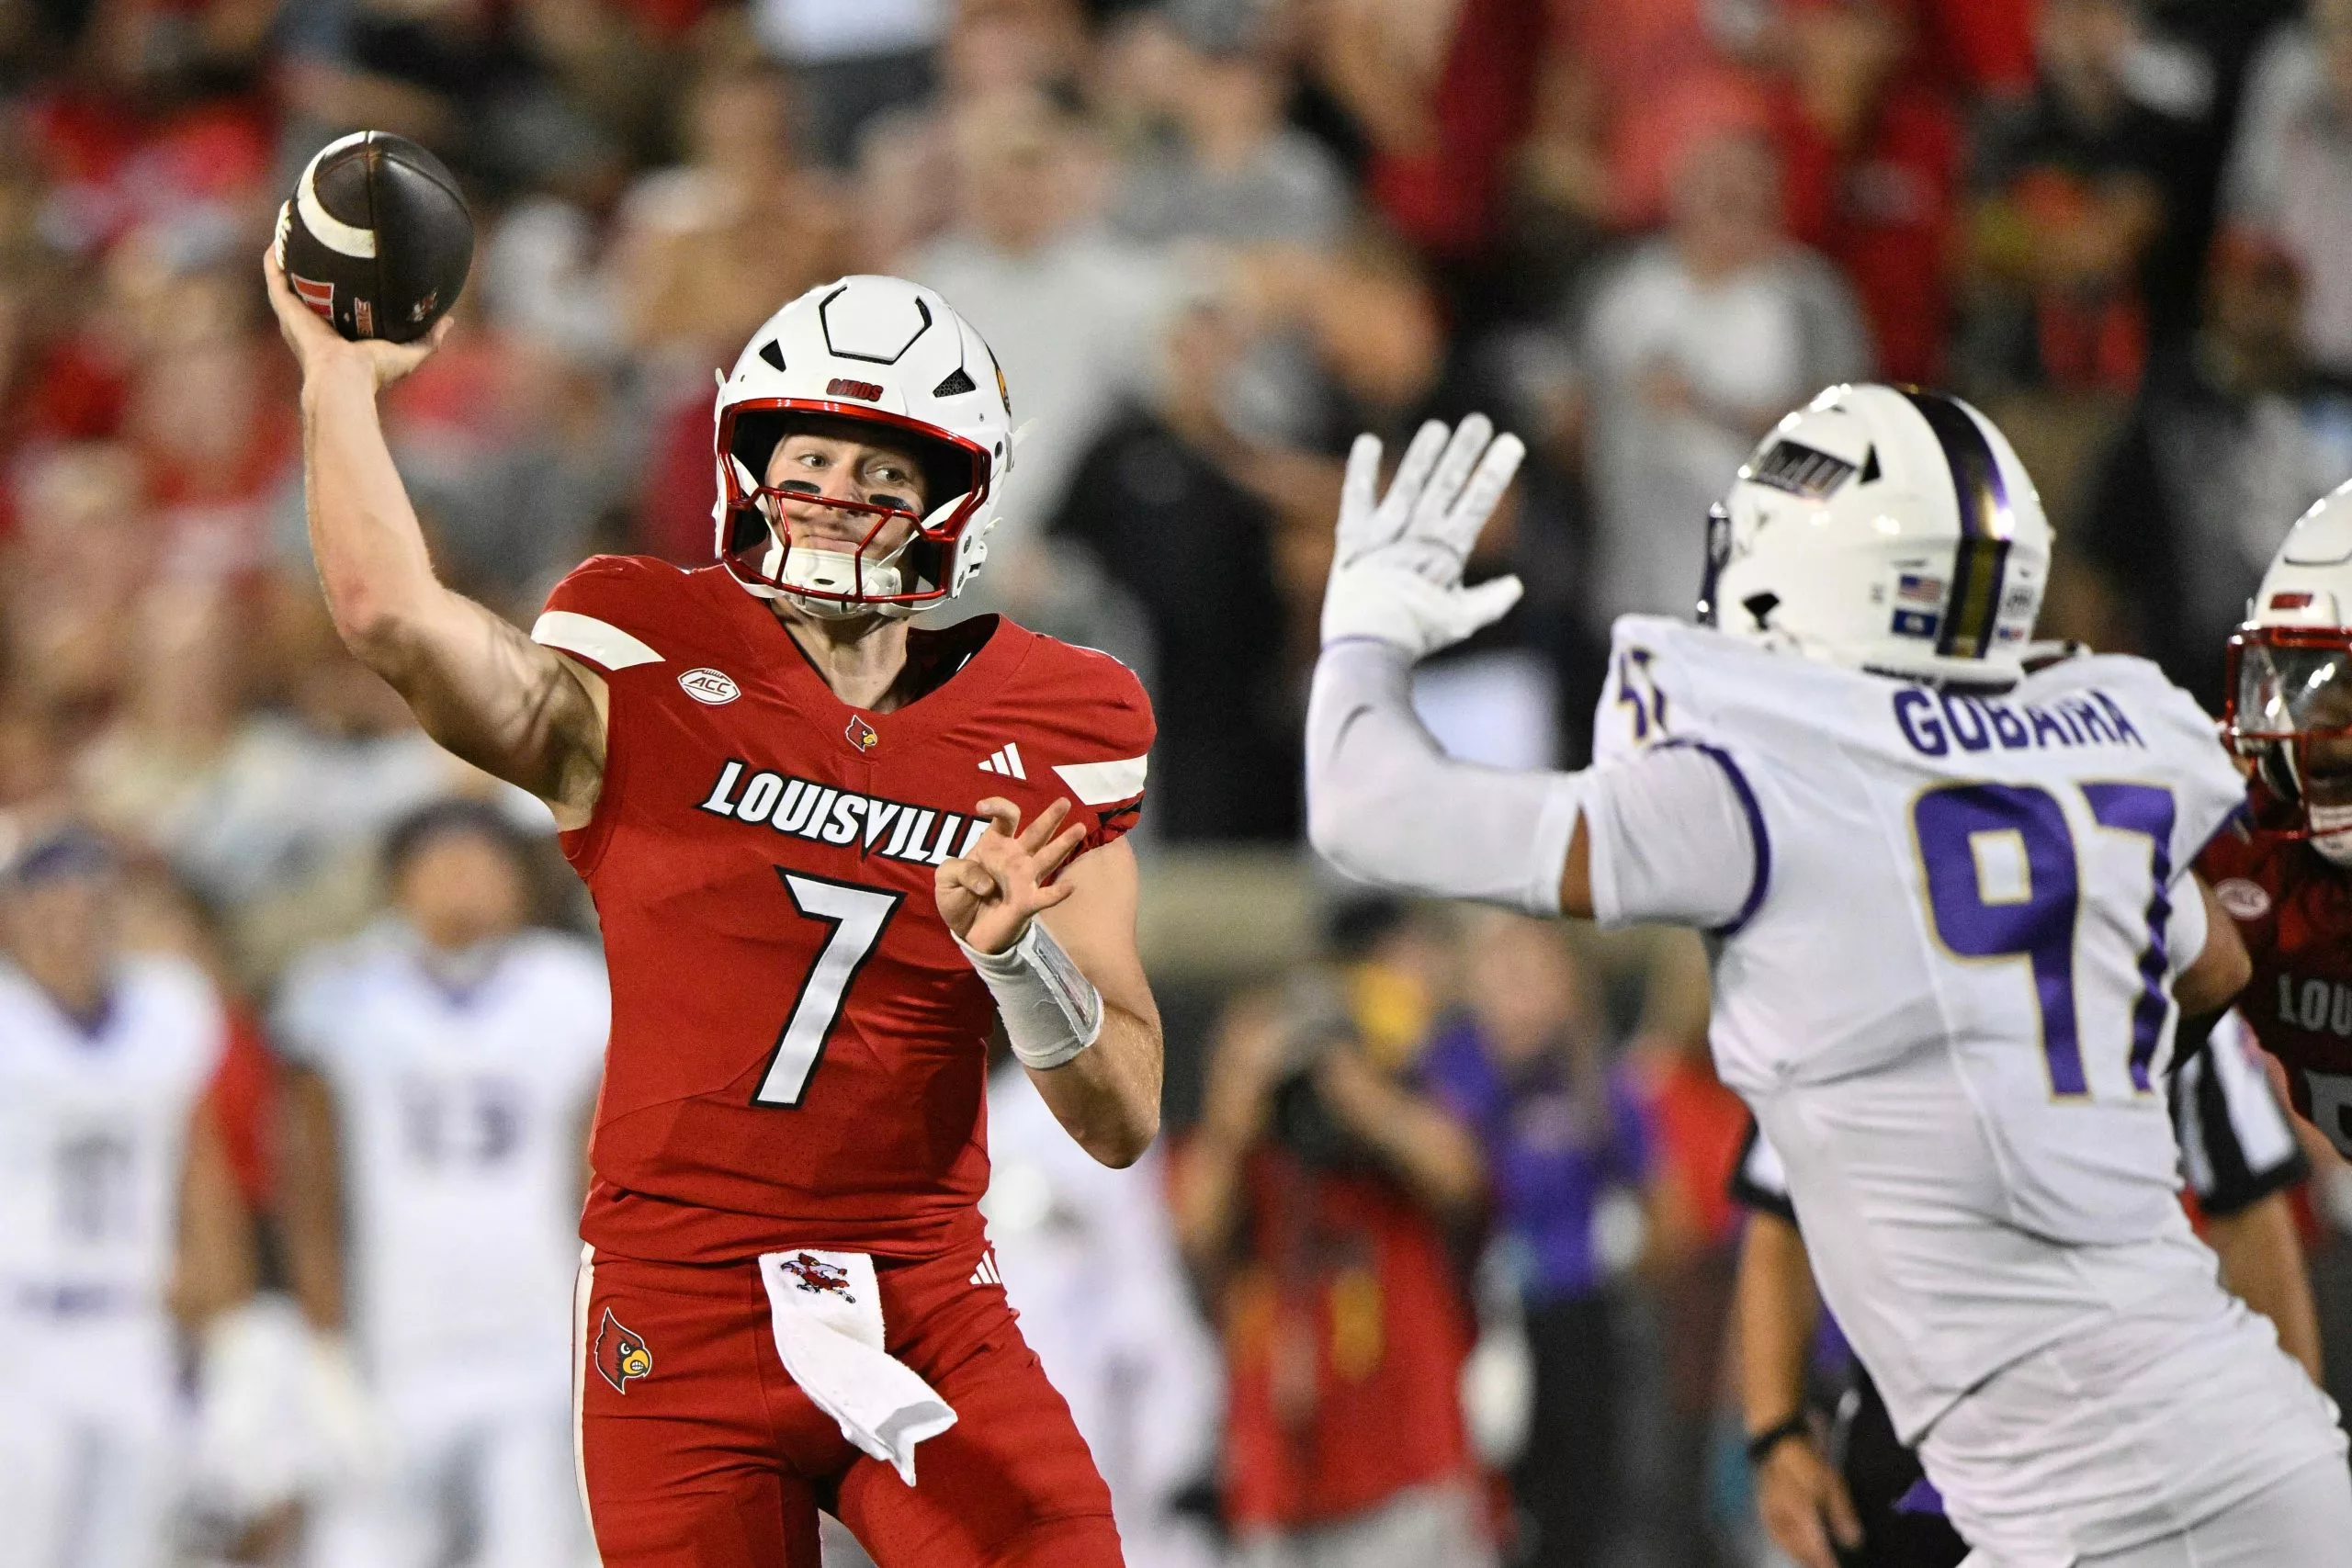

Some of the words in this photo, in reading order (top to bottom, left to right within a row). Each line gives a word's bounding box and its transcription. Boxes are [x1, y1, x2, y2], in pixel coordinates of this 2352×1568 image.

[688, 677, 732, 694] ACC
[752, 868, 905, 1108] 7
[1909, 779, 2177, 1102] 97
